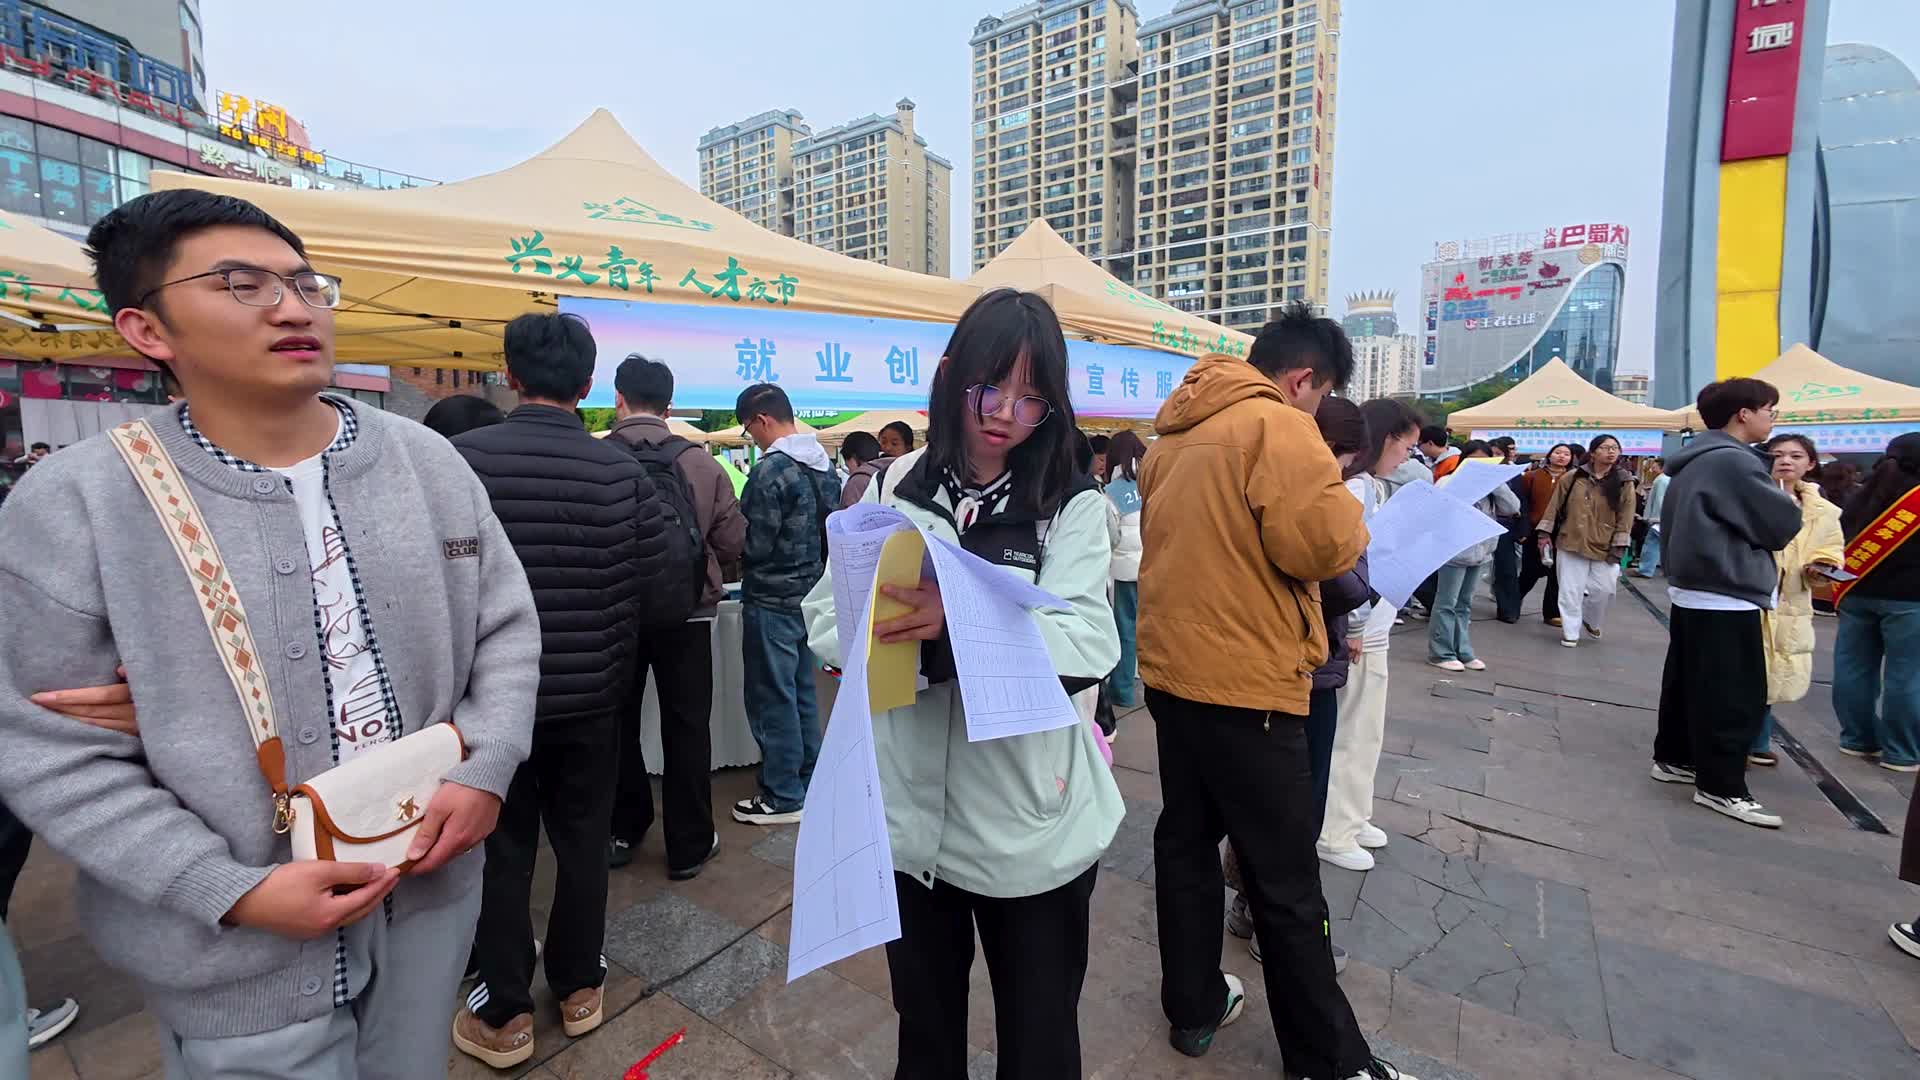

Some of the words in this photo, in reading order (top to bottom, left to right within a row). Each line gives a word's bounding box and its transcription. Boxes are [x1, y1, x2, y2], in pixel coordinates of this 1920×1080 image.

[503, 229, 662, 294] 兴义青年
[678, 255, 800, 306] 人才夜市
